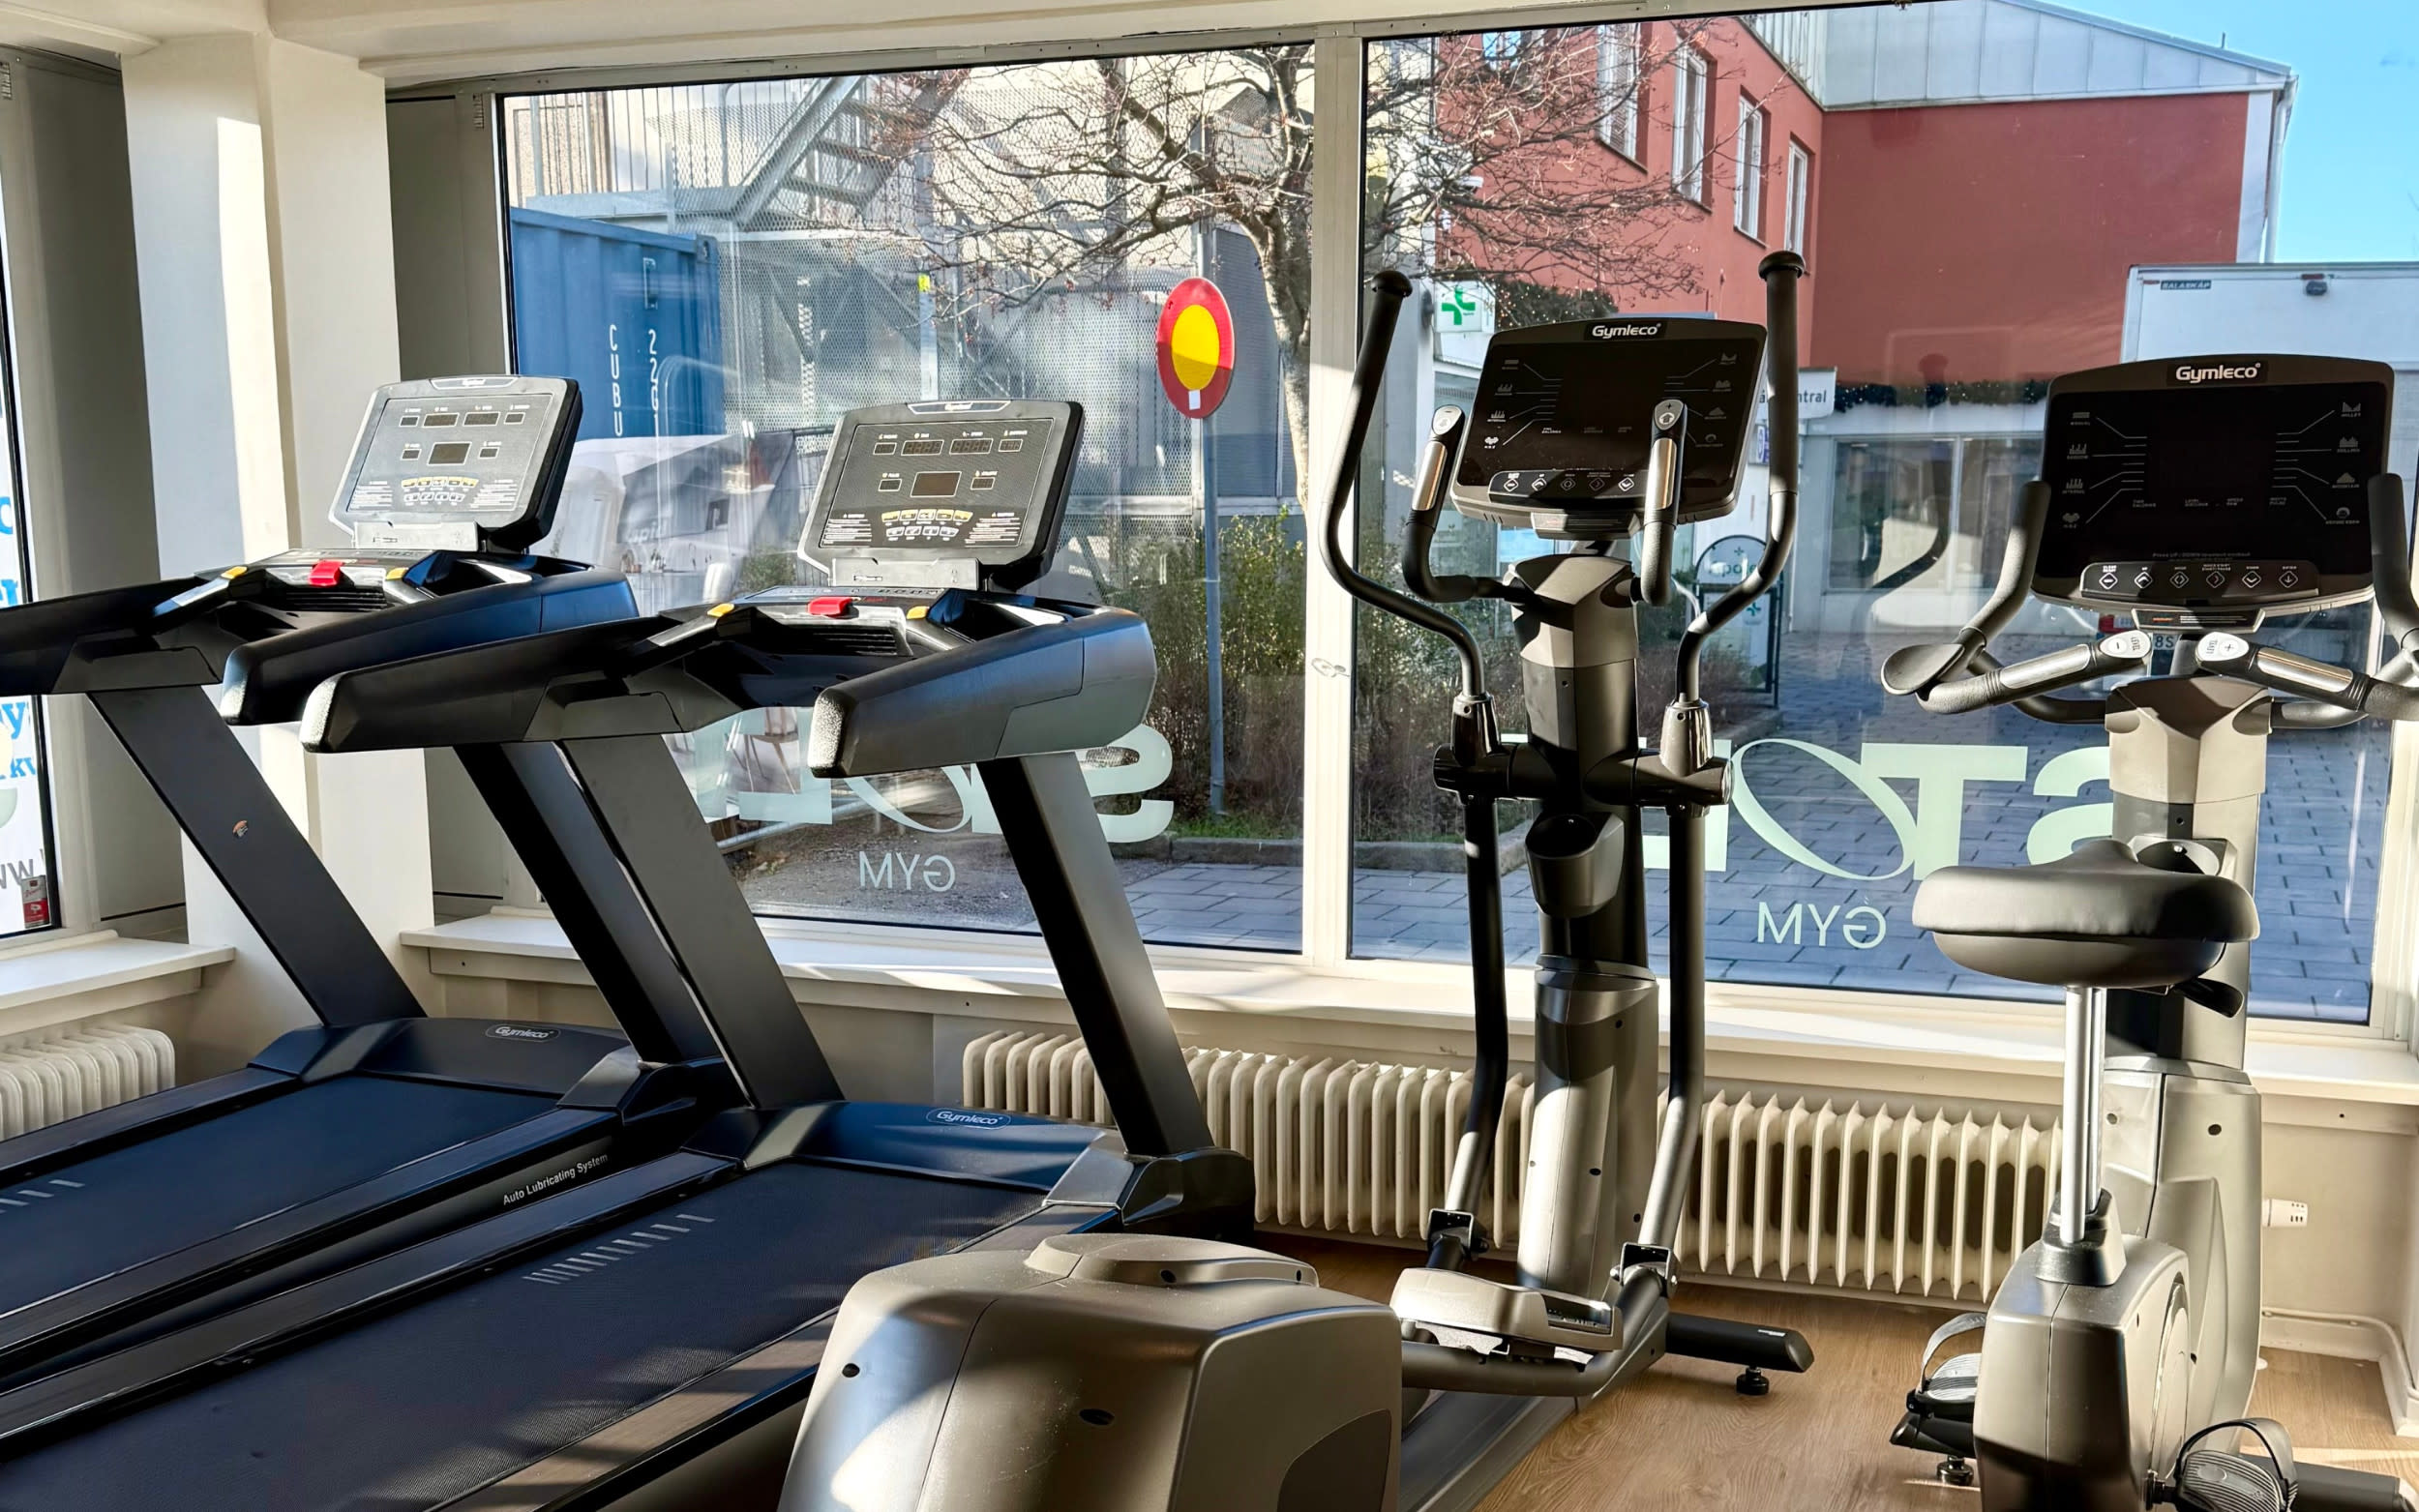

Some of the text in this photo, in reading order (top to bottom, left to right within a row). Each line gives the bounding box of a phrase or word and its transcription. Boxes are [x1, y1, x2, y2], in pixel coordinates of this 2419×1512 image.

[609, 323, 624, 436] CUBU
[503, 1154, 609, 1206] Auto Lubricating System
